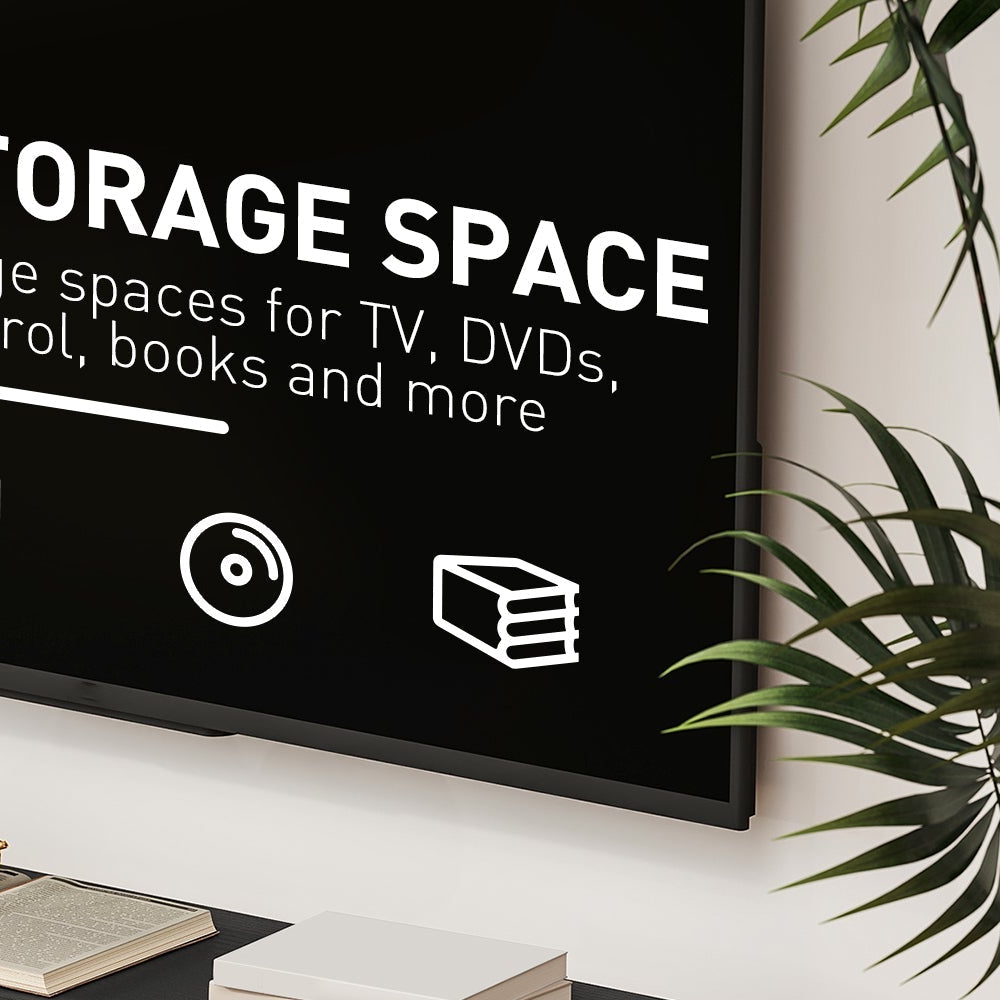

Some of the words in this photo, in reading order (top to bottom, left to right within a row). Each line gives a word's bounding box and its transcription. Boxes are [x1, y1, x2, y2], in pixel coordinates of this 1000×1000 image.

[381, 198, 710, 325] SPACE
[59, 268, 246, 327] spaces
[266, 286, 343, 341] for
[359, 300, 437, 365] TV,
[463, 315, 618, 394] DVDs,
[111, 319, 268, 389] books
[288, 361, 382, 408] and
[408, 380, 546, 432] more
